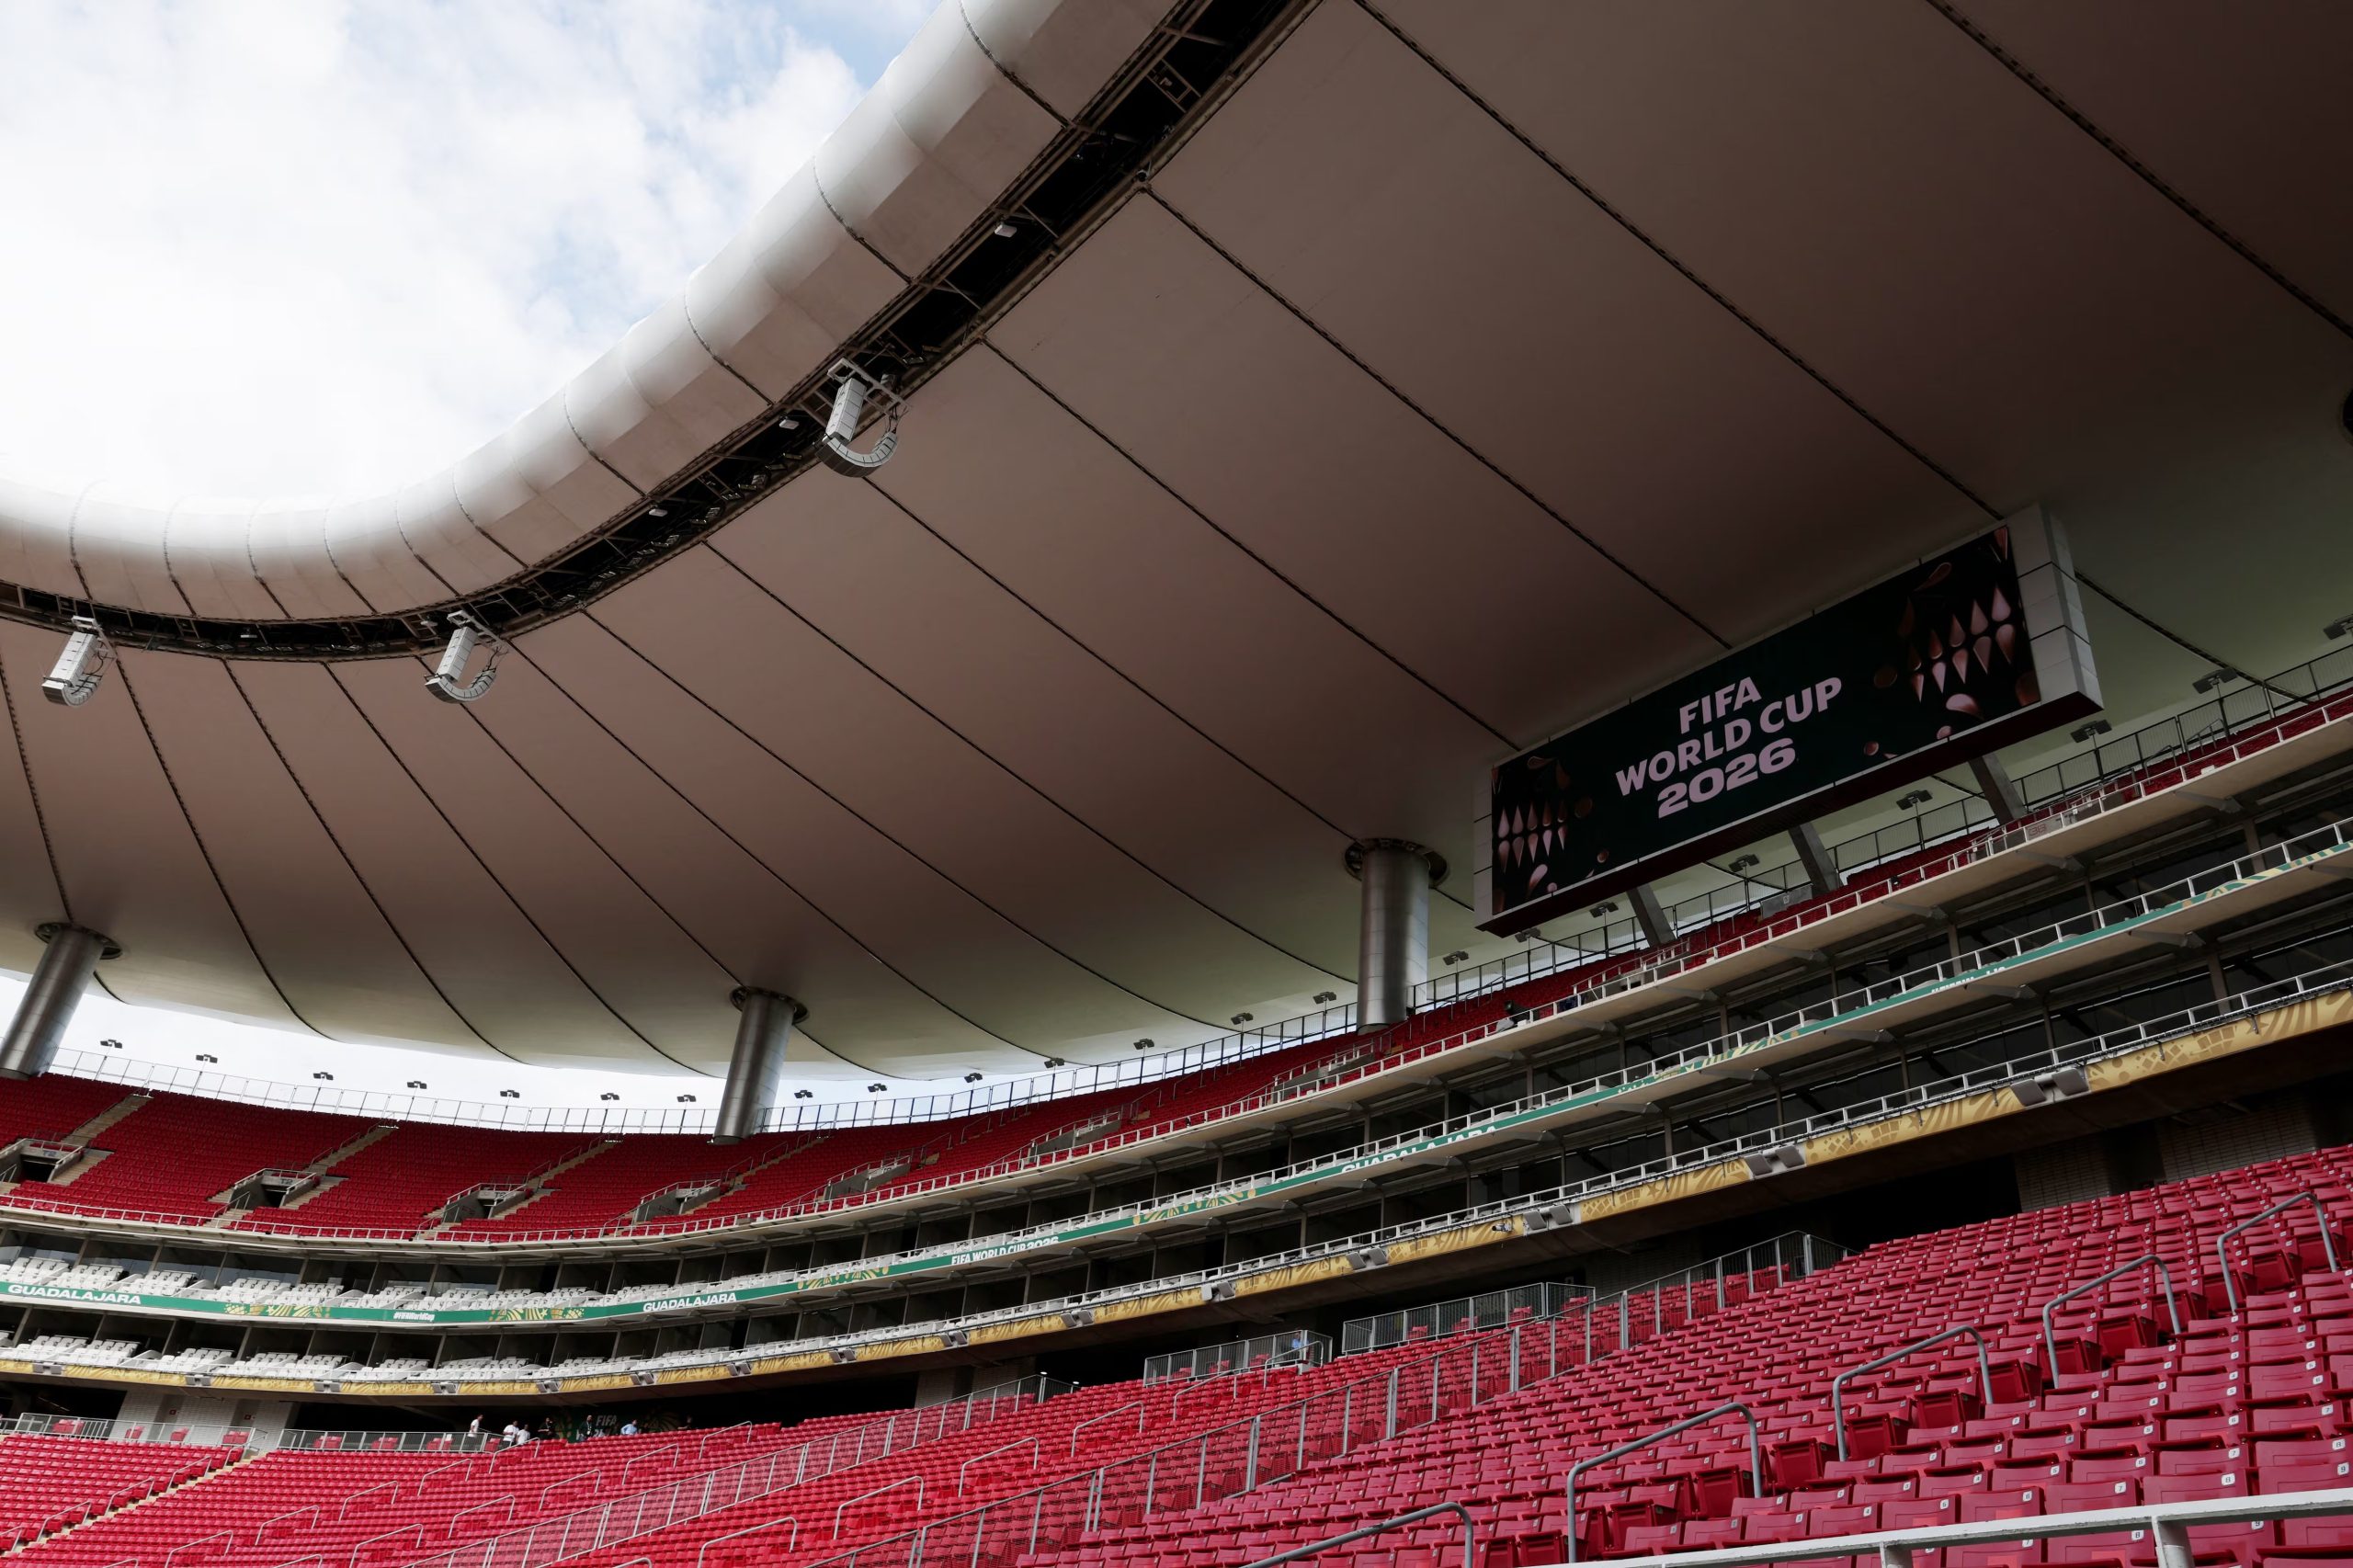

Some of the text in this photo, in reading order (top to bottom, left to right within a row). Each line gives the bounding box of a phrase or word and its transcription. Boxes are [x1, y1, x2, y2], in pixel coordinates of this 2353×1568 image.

[1679, 676, 1762, 734] FIFA
[1615, 677, 1842, 796] WORLD CUP
[1657, 737, 1796, 819] 2026
[951, 1255, 972, 1266] FIFA
[972, 1247, 1006, 1263] WORLD
[1007, 1243, 1026, 1253] CUP
[7, 1284, 142, 1305] GUADALAJARA
[642, 1292, 737, 1312] GUADALAJARA
[596, 1415, 617, 1426] FIFA
